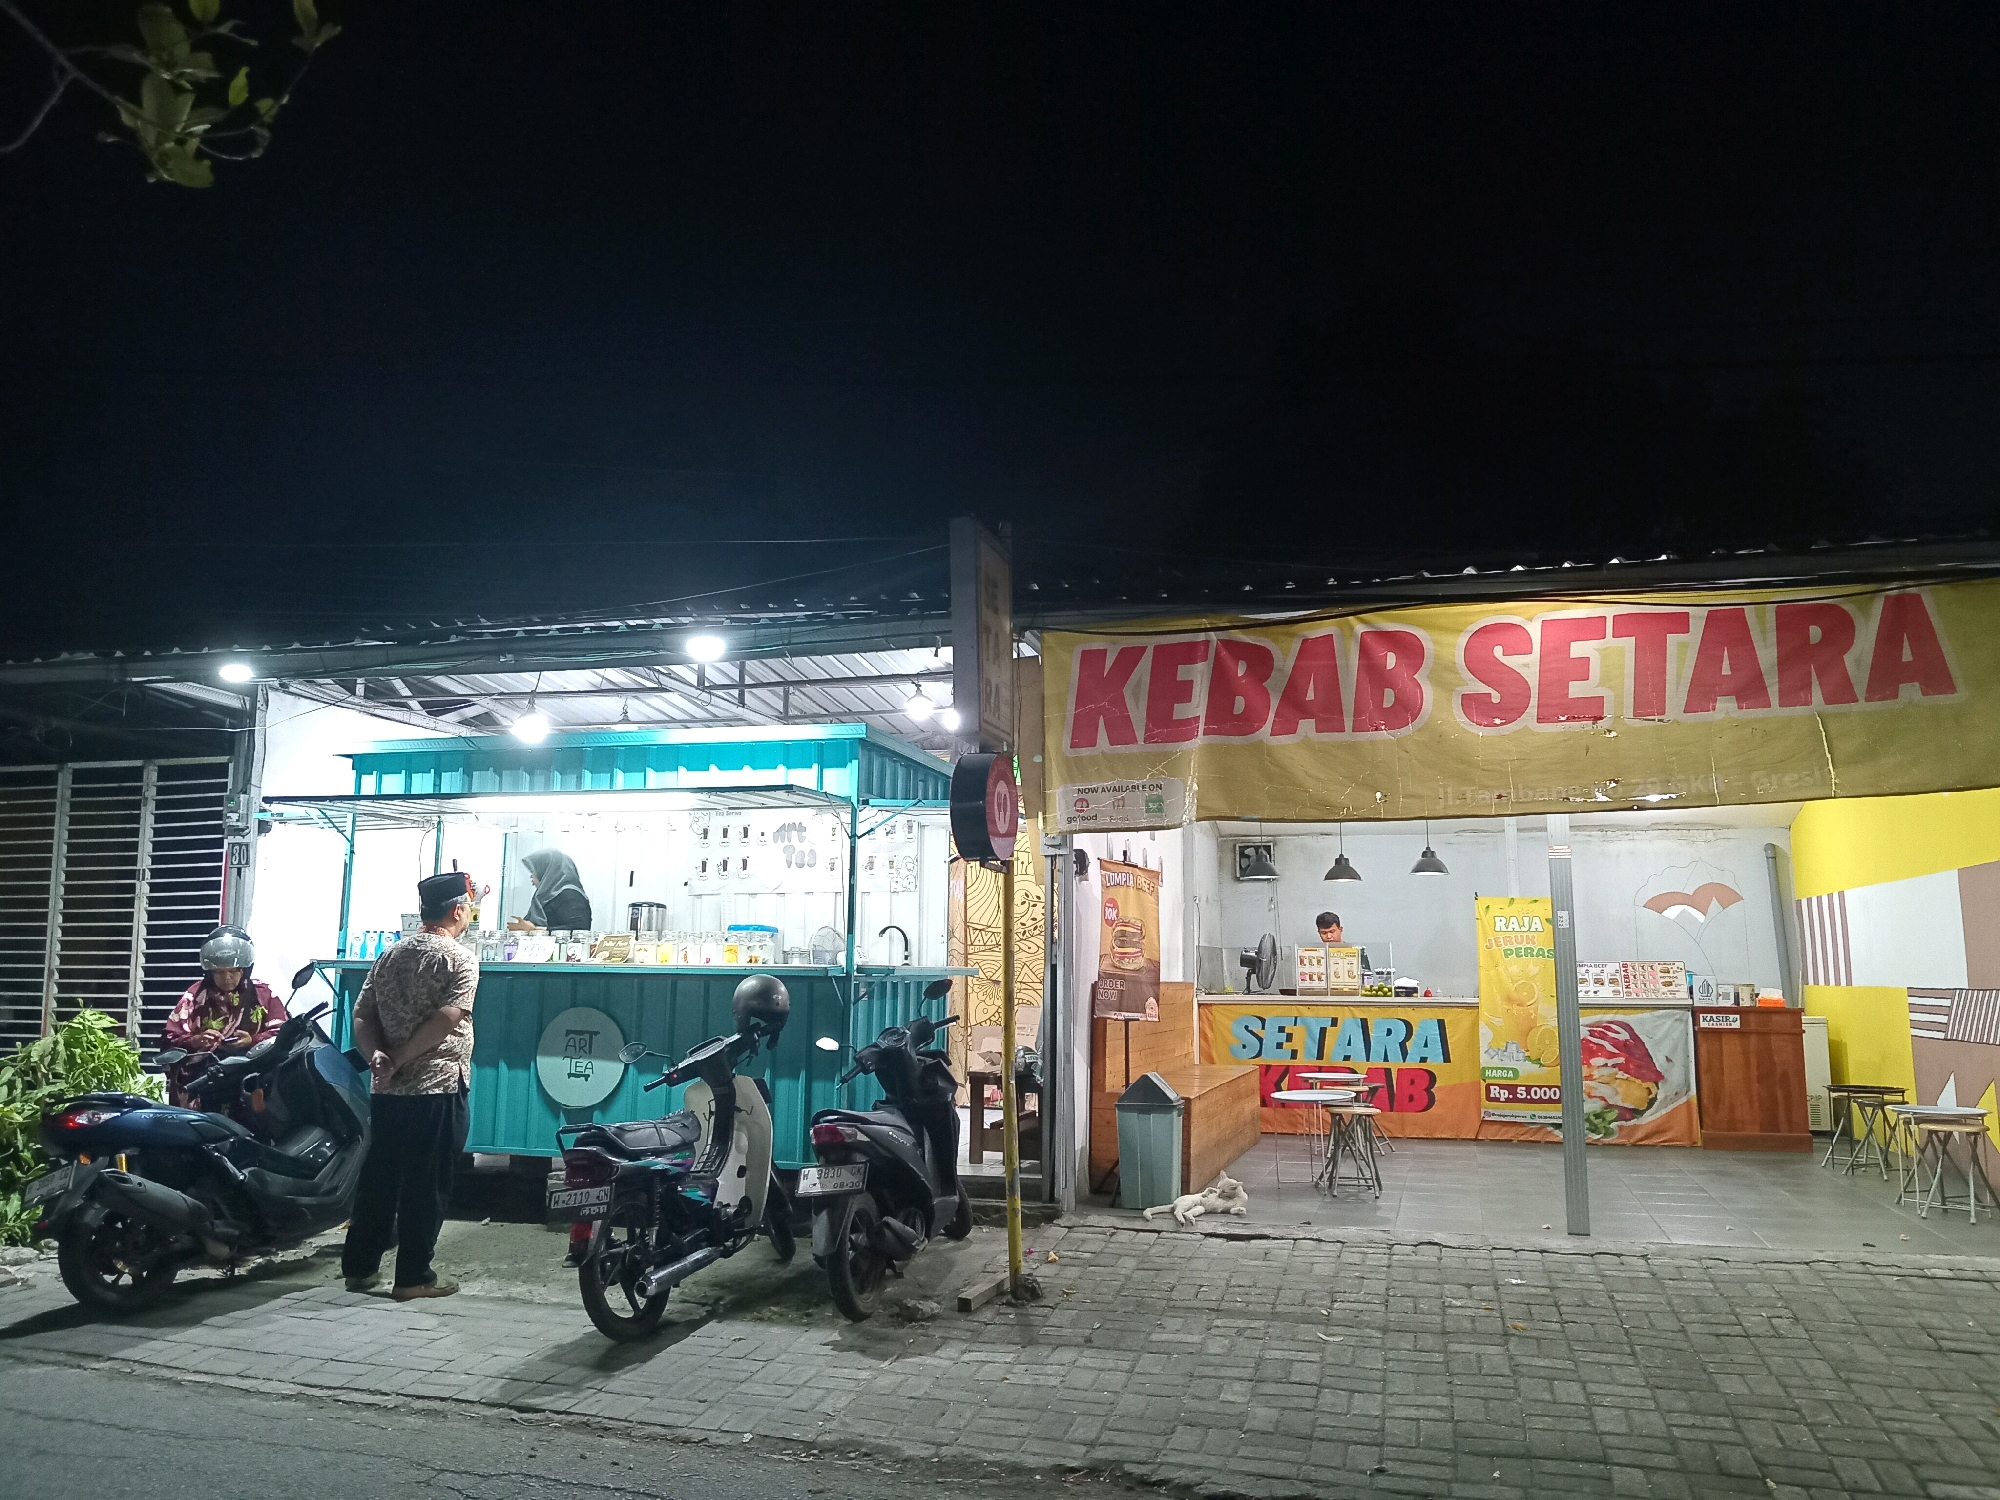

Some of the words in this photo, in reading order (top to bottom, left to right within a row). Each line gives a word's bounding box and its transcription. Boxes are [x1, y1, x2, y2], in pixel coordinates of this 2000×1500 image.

[1068, 627, 1428, 750] KEBAB
[1459, 591, 1958, 728] SETARA
[1077, 786, 1099, 795] NOW
[1101, 784, 1147, 793] AVAILABLE
[1148, 783, 1163, 792] ON
[773, 822, 807, 843] Art
[232, 845, 247, 865] 30
[782, 845, 816, 868] Tea
[1136, 875, 1155, 895] BEEF
[1105, 907, 1118, 920] 10K
[1494, 916, 1544, 932] RAJA
[1485, 934, 1537, 950] JERUK
[1503, 946, 1555, 959] PERAS
[1098, 978, 1125, 990] ORDER
[1097, 989, 1118, 1000] NOW
[1702, 1015, 1731, 1023] KASIR
[564, 1029, 601, 1056] ART
[1229, 1014, 1451, 1064] SETARA
[562, 1055, 595, 1080] TEA
[1485, 1069, 1514, 1078] HARGA
[1489, 1085, 1513, 1101] Rp.
[1516, 1086, 1560, 1100] 5.000
[802, 1169, 810, 1181] W
[552, 1193, 560, 1207] W
[566, 1190, 590, 1206] 2119
